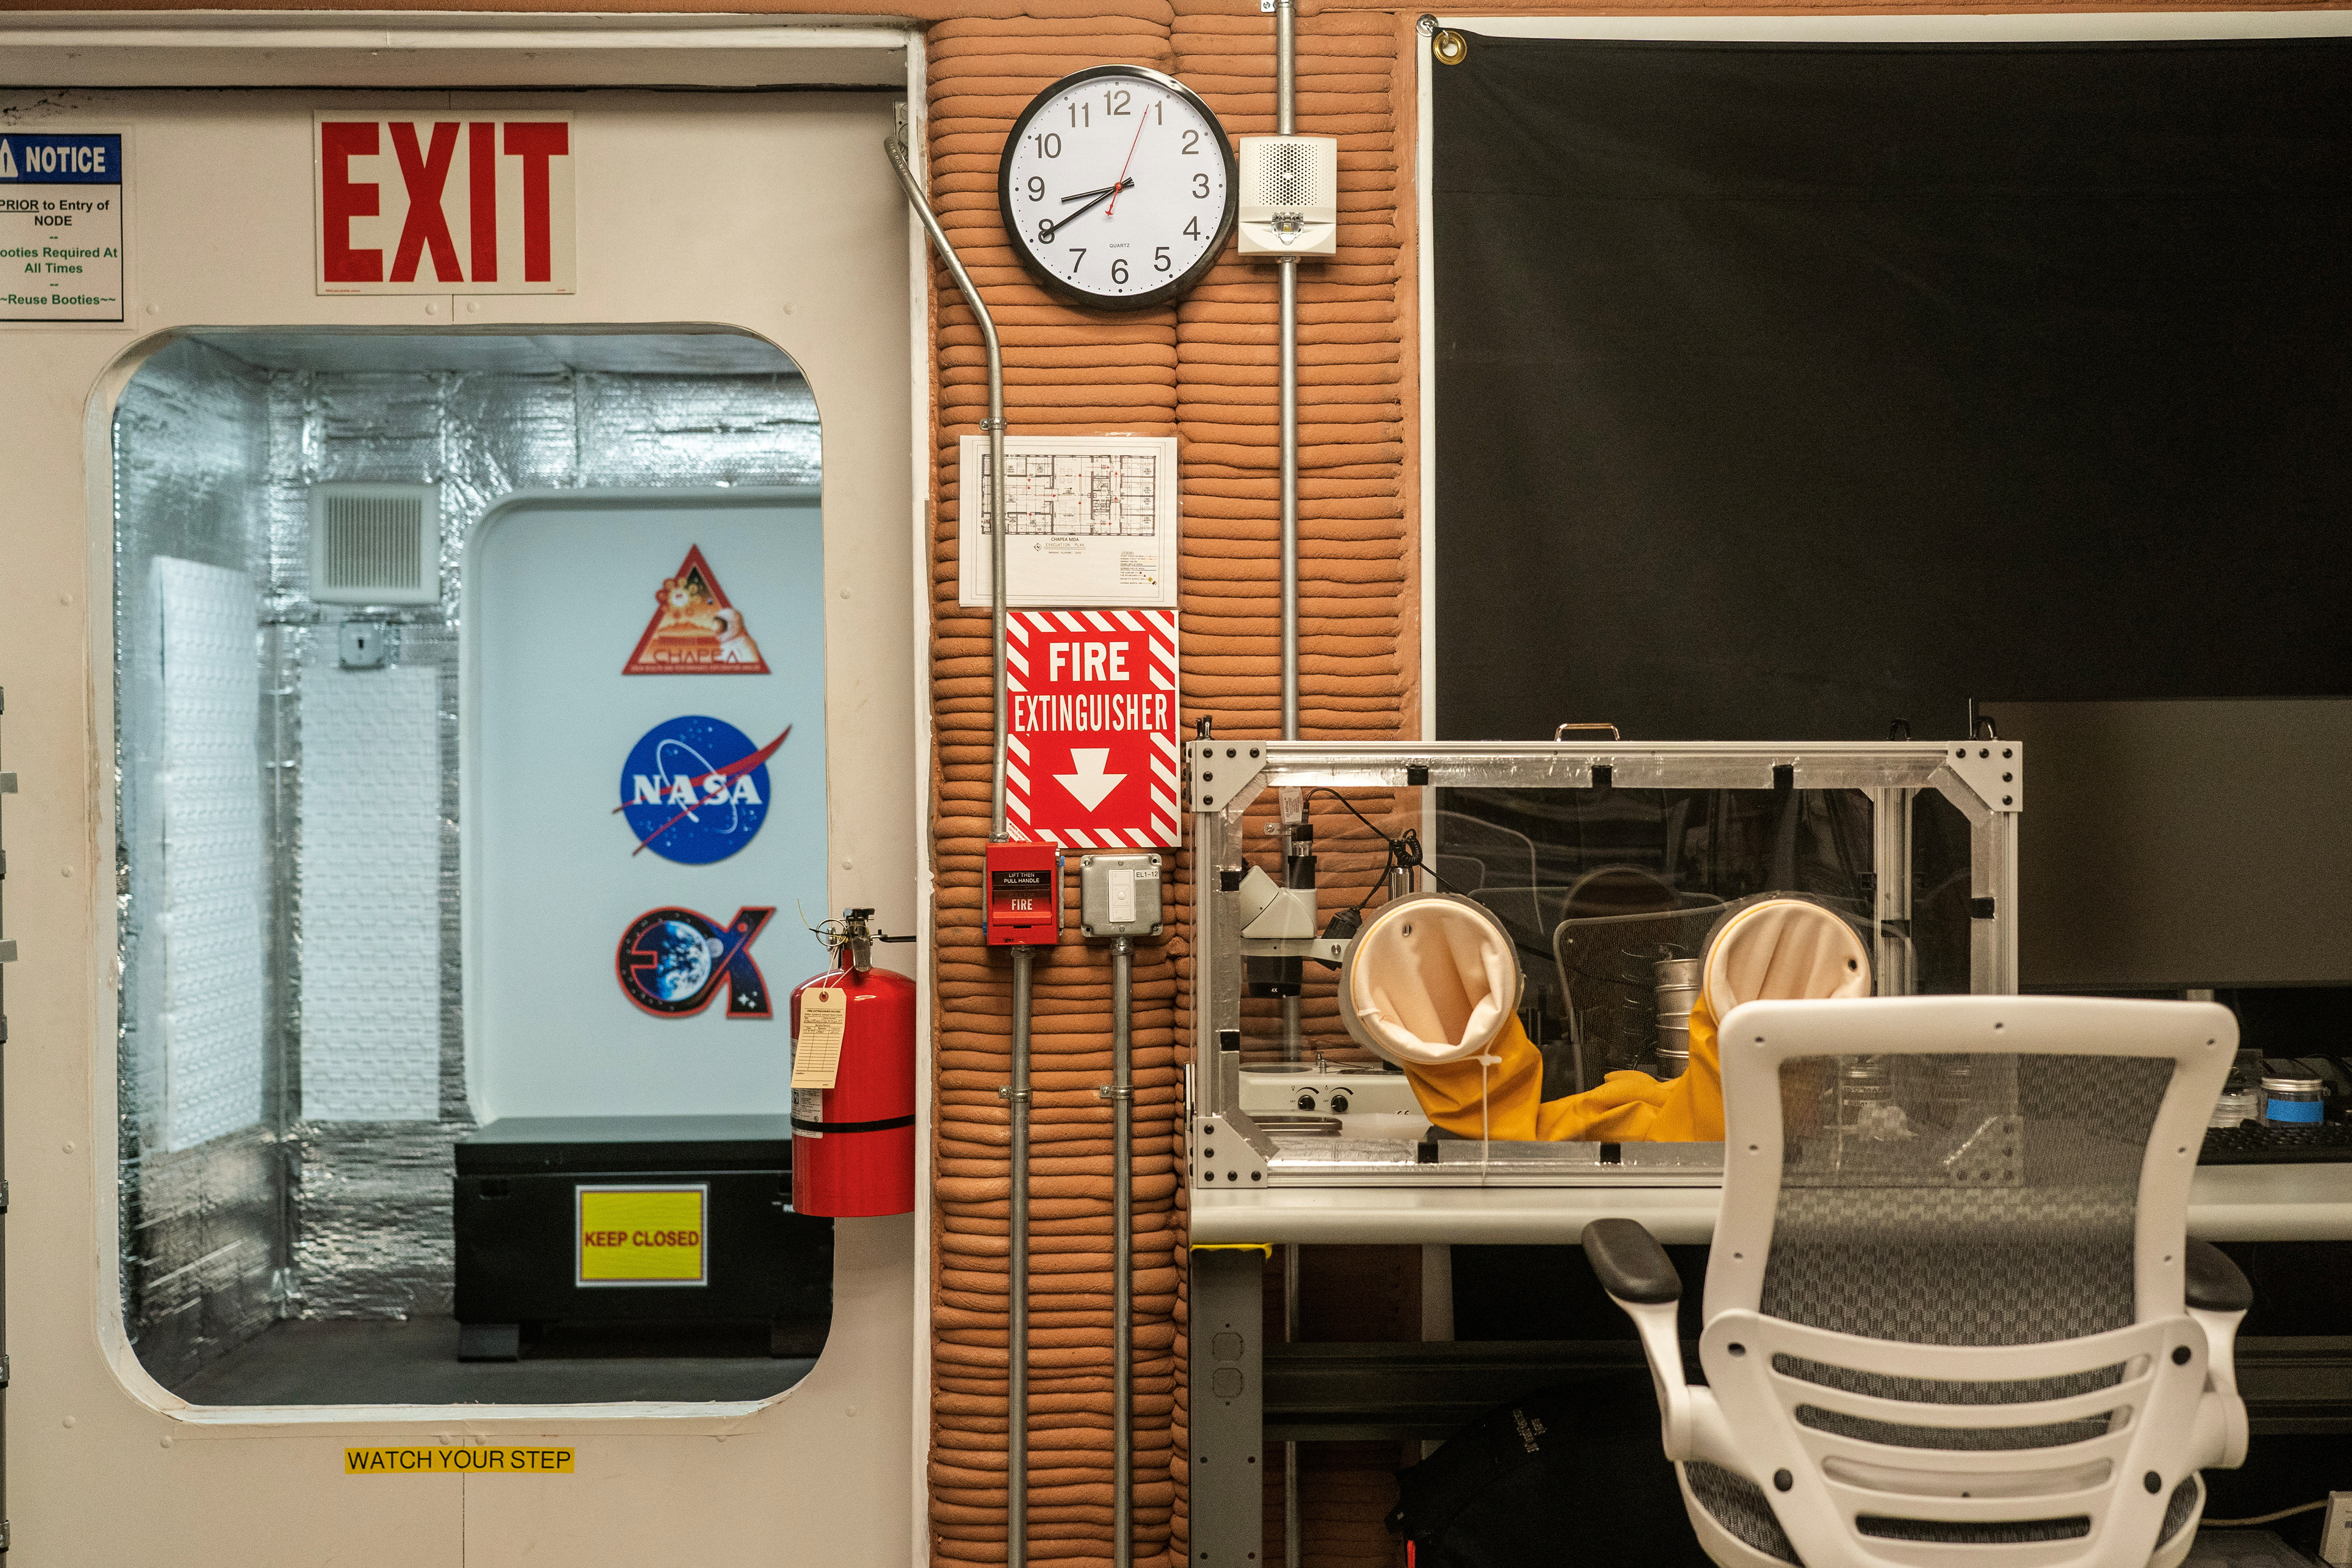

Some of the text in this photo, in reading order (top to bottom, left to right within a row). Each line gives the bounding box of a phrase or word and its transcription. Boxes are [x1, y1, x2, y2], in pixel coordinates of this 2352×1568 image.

[1068, 102, 1089, 128] 11
[1103, 90, 1131, 116] 12
[1154, 100, 1162, 125] 1
[1035, 133, 1062, 158] 10
[1182, 130, 1199, 155] 2
[26, 146, 105, 173] NOTICE
[1028, 176, 1045, 202] 9
[1192, 174, 1209, 199] 3
[43, 200, 55, 210] to
[60, 200, 93, 213] Entry
[97, 200, 109, 210] of
[321, 122, 569, 282] EXIT
[34, 215, 72, 226] NODE
[1038, 218, 1055, 244] 8
[1183, 216, 1201, 241] 4
[0, 247, 118, 260] ooties Required At
[1069, 248, 1087, 273] 7
[1154, 247, 1171, 272] 5
[25, 263, 83, 273] All Times
[1111, 259, 1129, 284] 6
[1050, 641, 1130, 682] FIRE
[1014, 694, 1168, 732] EXTINGUISHER
[632, 774, 763, 805] NASA
[1011, 899, 1033, 910] FIRE
[585, 1230, 699, 1247] KEEP CLOSED
[348, 1450, 571, 1469] WATCH YOUR STEP
